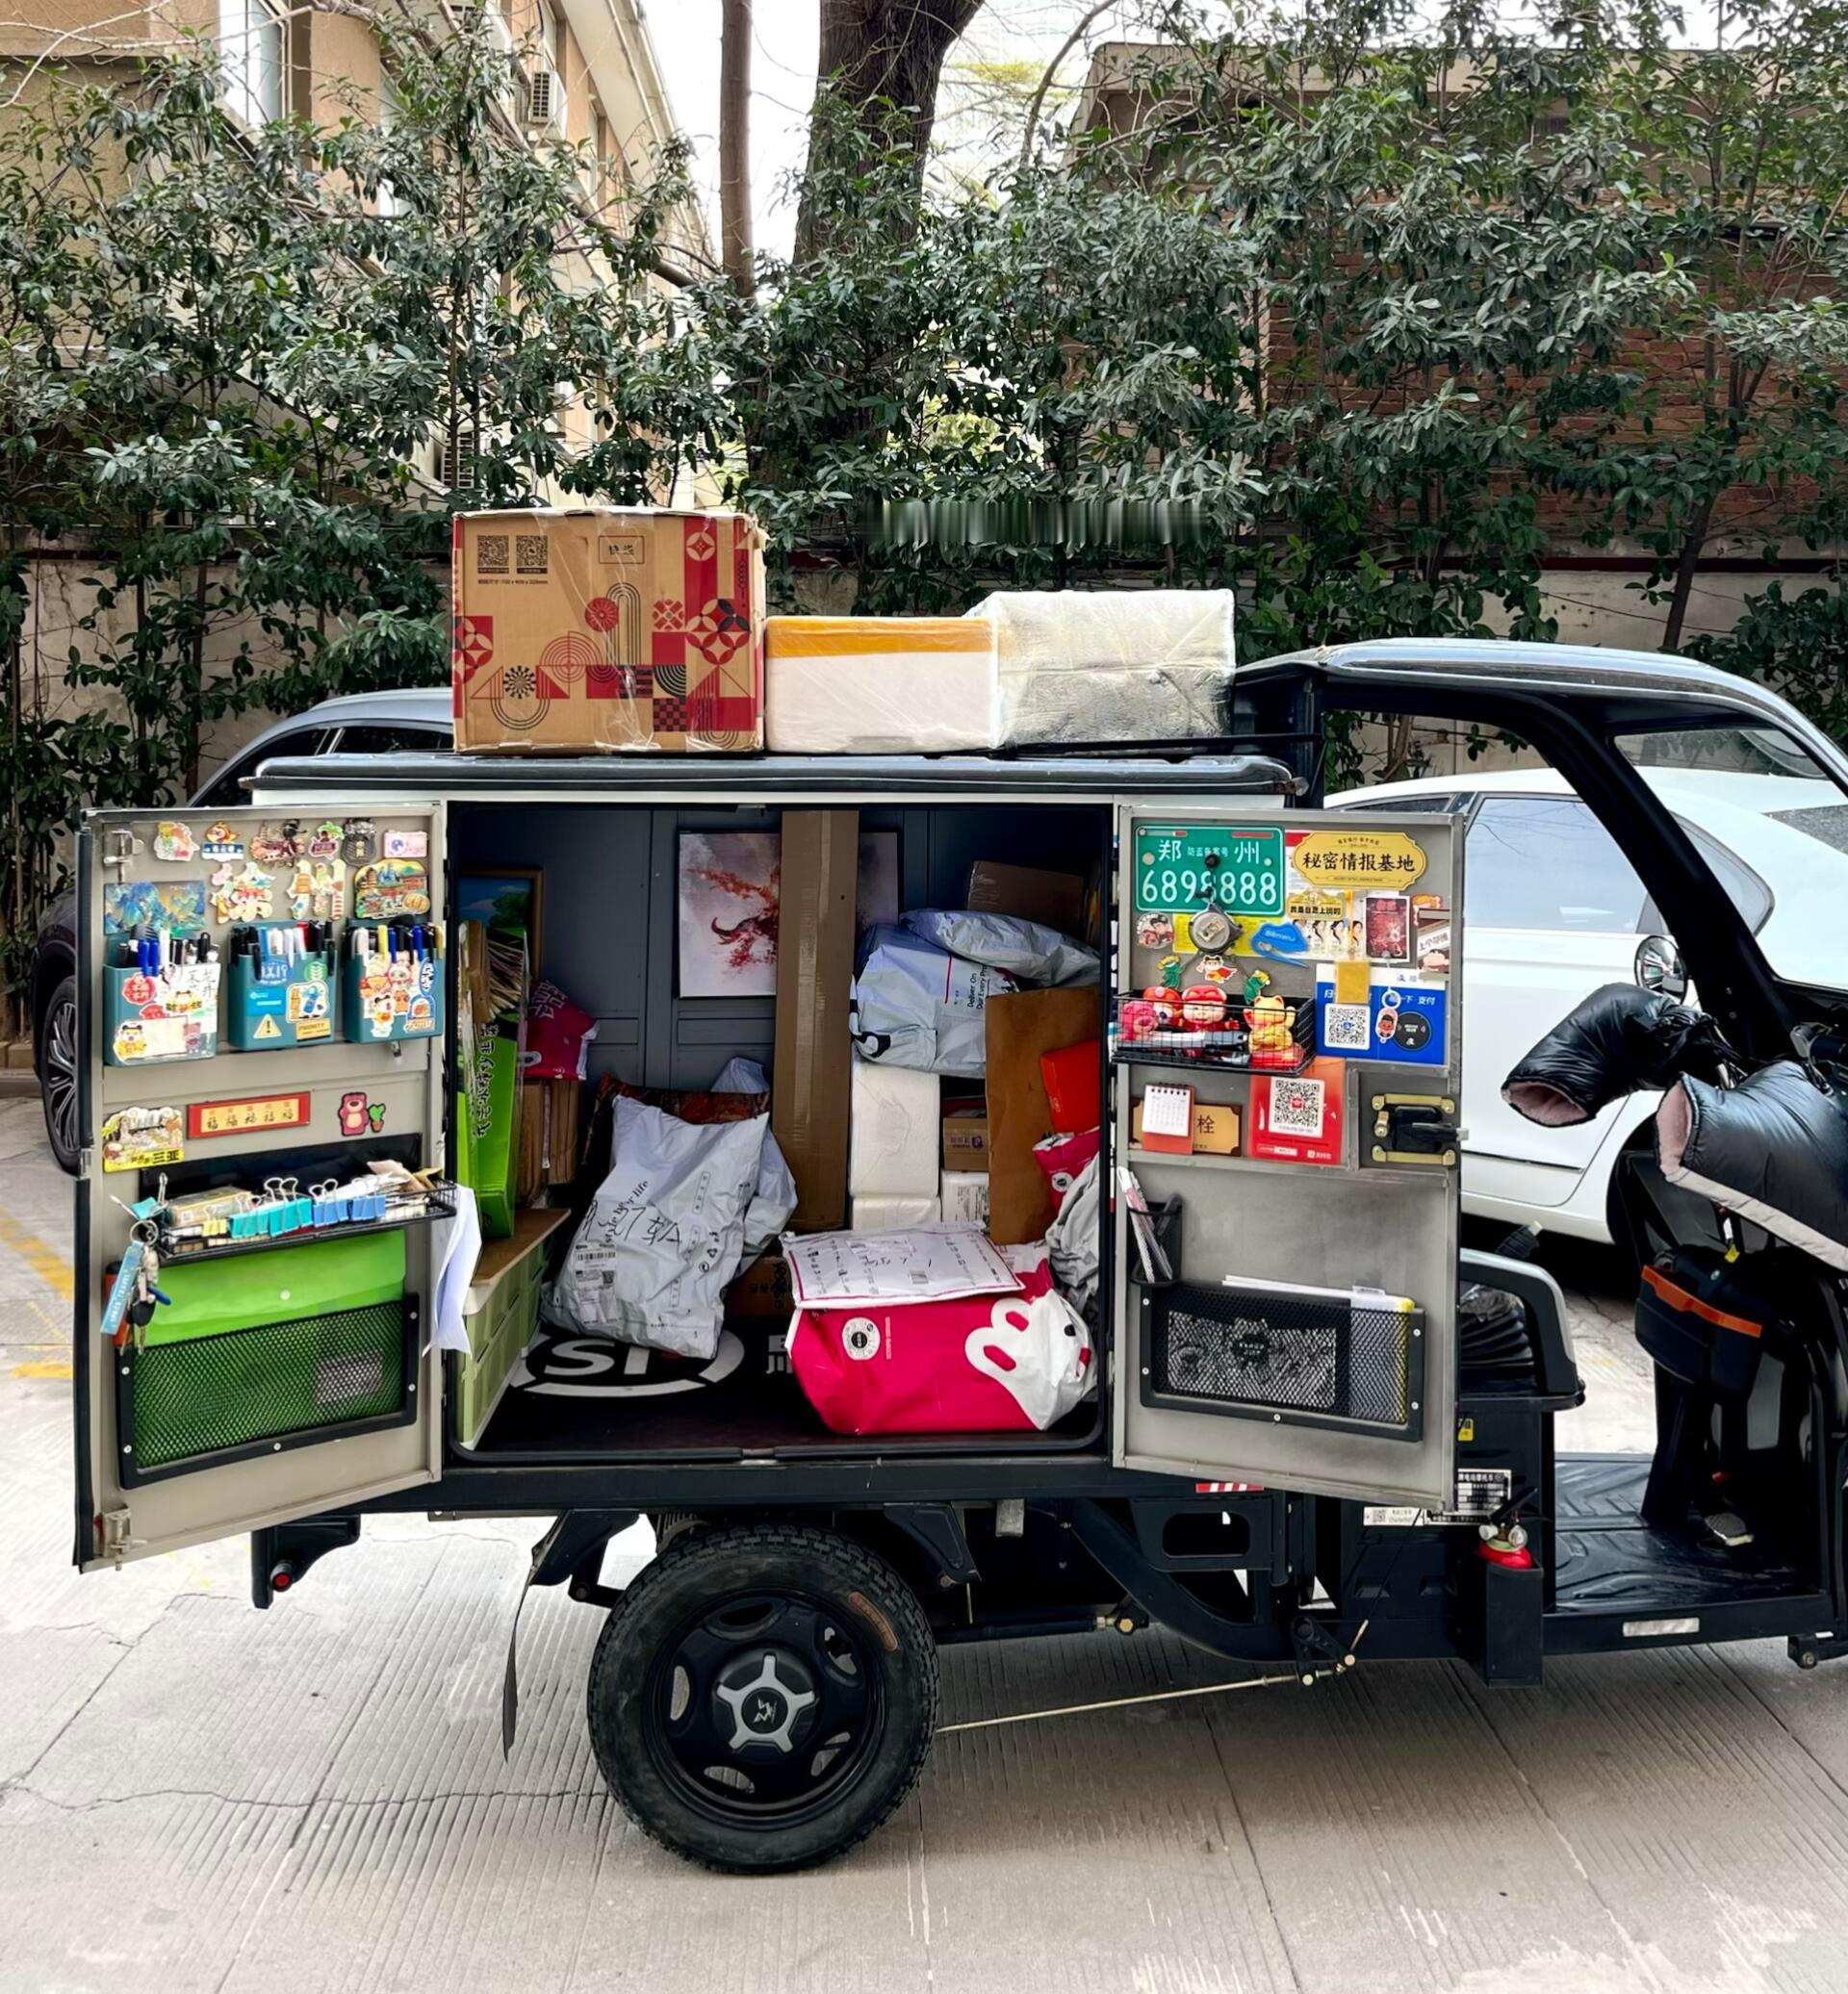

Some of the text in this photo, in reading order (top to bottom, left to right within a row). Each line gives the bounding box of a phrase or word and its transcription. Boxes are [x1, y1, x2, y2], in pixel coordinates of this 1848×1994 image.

[1158, 839, 1182, 862] 郑
[1234, 840, 1260, 864] 州
[1302, 852, 1416, 872] 秘密情报基地
[1142, 869, 1277, 906] 6898888
[967, 973, 977, 1008] Deliver On
[1197, 1114, 1215, 1134] 栓
[153, 1150, 180, 1163] 三亚
